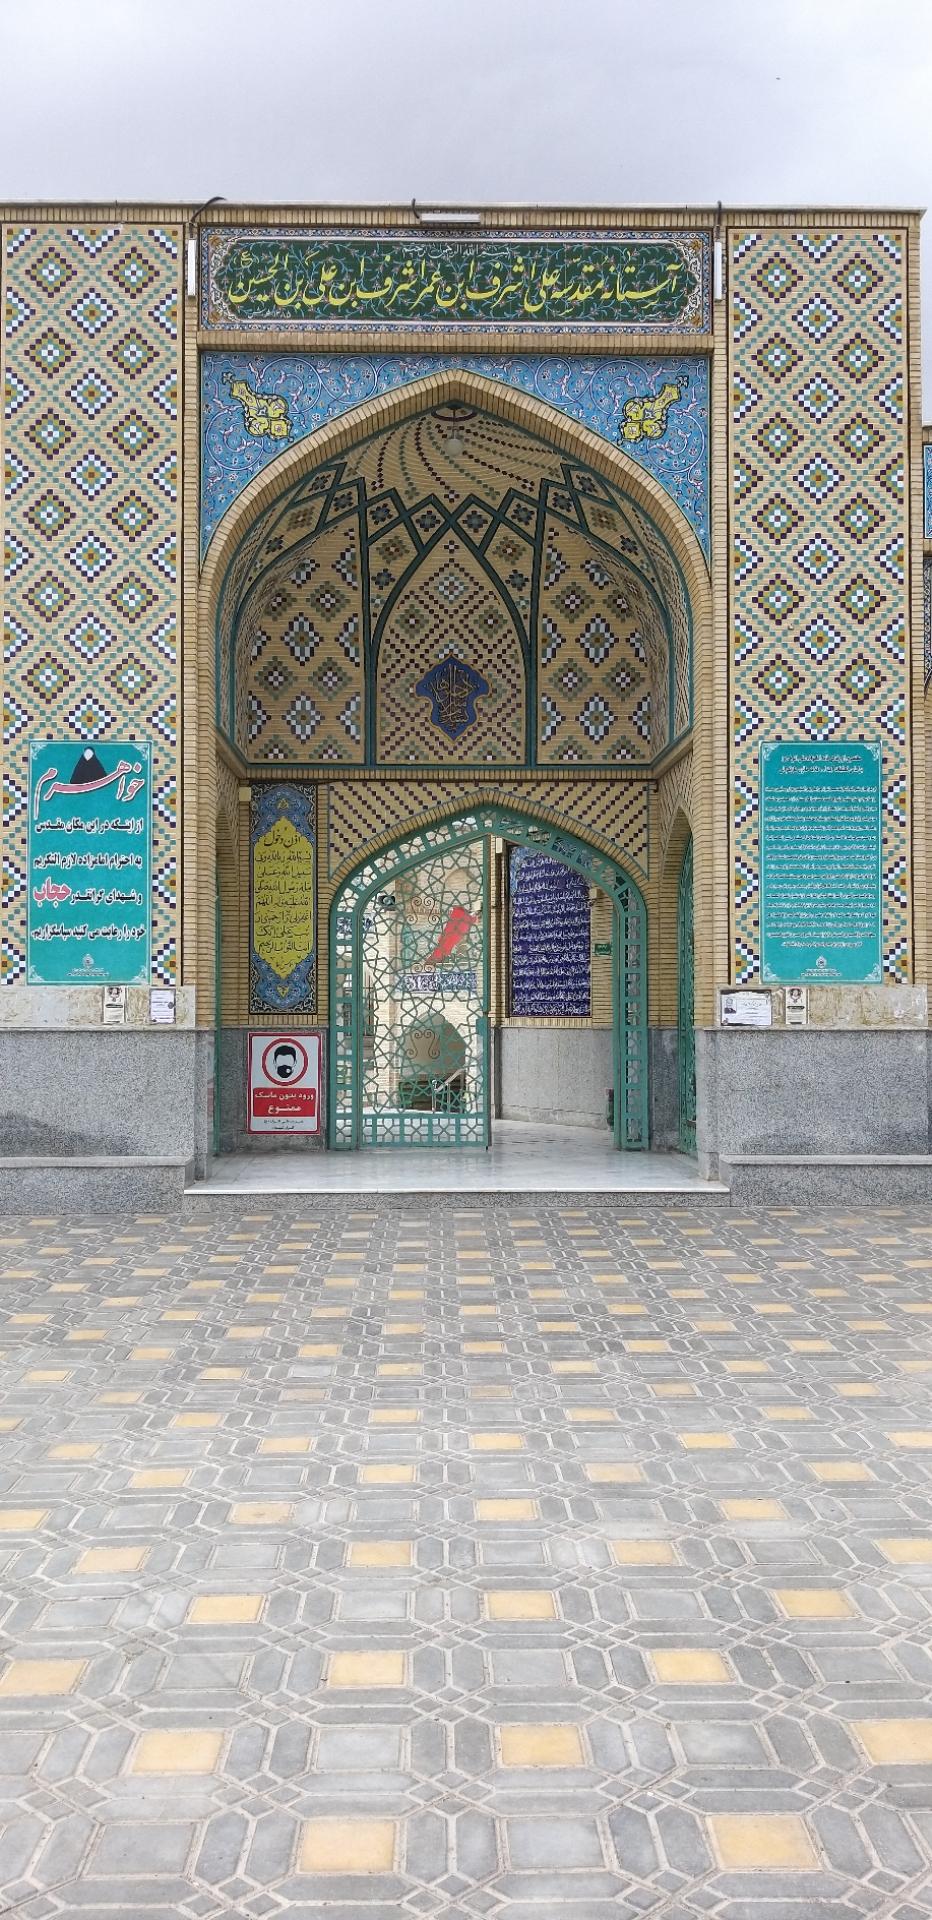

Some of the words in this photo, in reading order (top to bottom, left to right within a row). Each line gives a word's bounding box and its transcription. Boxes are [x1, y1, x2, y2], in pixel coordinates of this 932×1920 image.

[466, 257, 536, 308] اشرف
[524, 268, 560, 312] علی
[33, 760, 145, 820] خواهرم
[35, 818, 64, 833] مقدس
[65, 817, 84, 834] مکان
[86, 818, 98, 834] این
[100, 820, 111, 834] در
[111, 818, 134, 833] اینکه
[135, 817, 144, 834] از
[33, 852, 60, 869] التکریم
[61, 853, 77, 868] لازم
[78, 853, 108, 869] امامزاده
[110, 853, 133, 868] احترام
[134, 855, 142, 869] به
[33, 877, 71, 907] حجاب
[105, 888, 135, 904] شهدای
[136, 893, 142, 905] و
[101, 924, 123, 940] رعایت
[124, 925, 132, 940] را
[132, 924, 146, 940] خود
[279, 1093, 297, 1101] بدون
[299, 1093, 314, 1101] ورود
[267, 1103, 302, 1115] ممنوع
